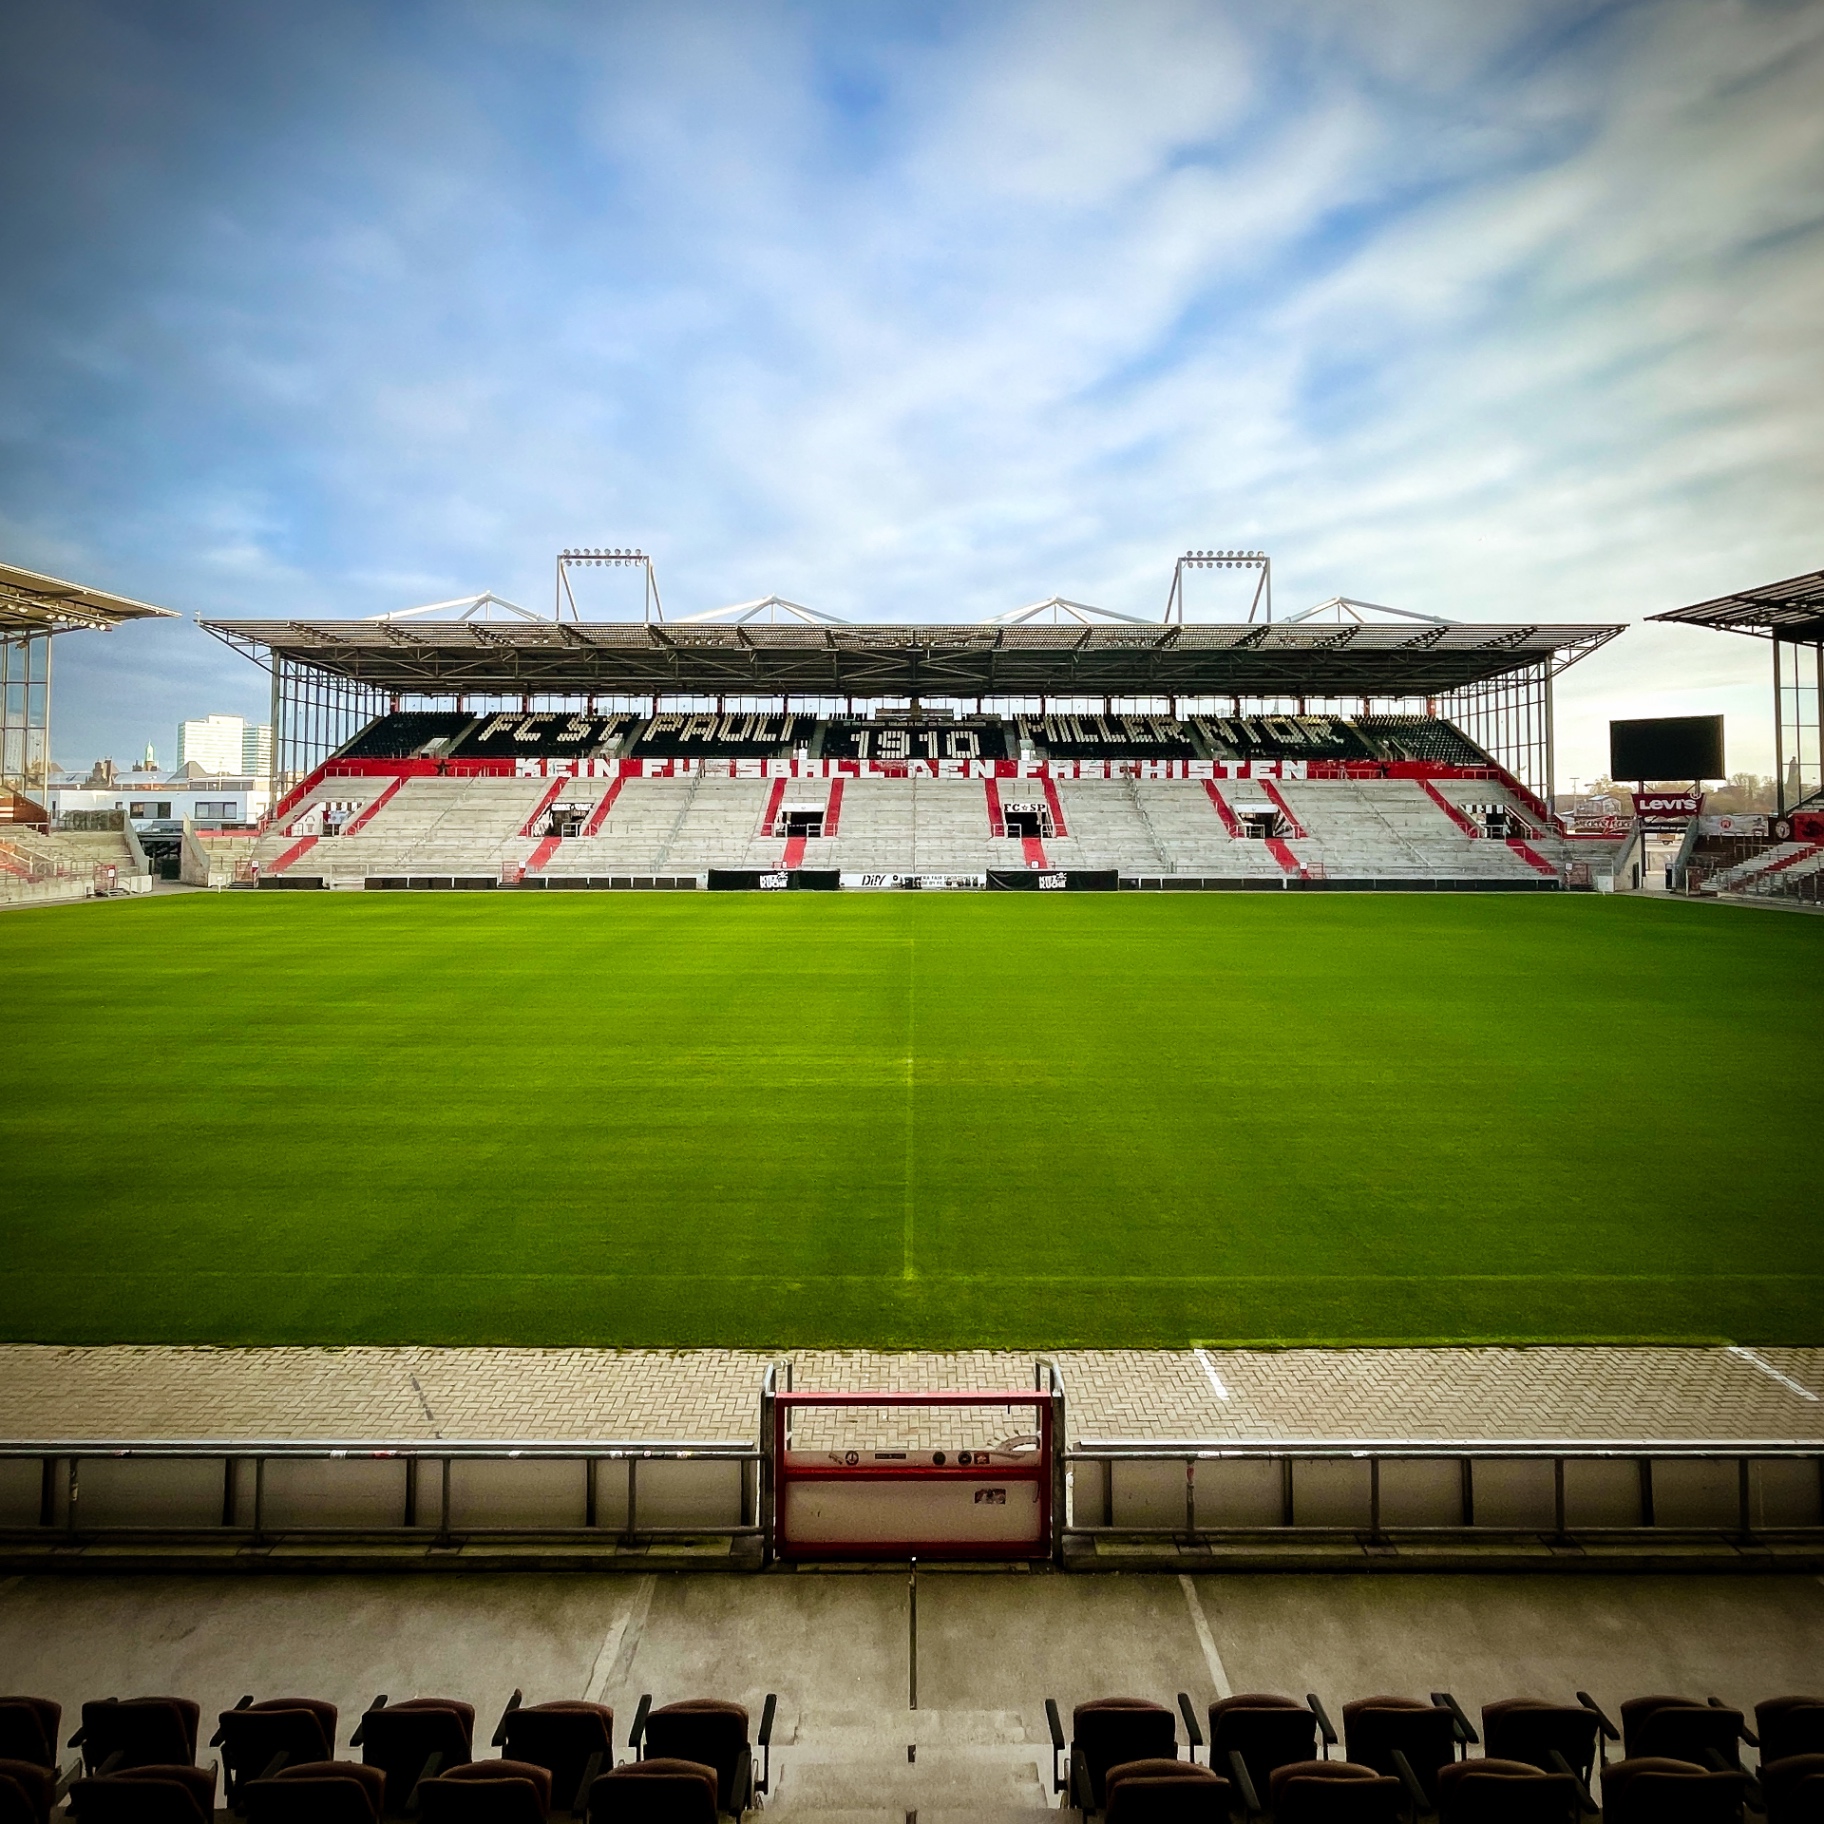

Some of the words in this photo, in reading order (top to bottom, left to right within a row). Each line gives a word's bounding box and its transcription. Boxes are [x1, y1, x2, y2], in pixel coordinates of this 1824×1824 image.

[478, 713, 556, 741] FC
[642, 714, 795, 742] PAULI
[850, 731, 981, 758] 1910
[516, 758, 620, 777] KEIN
[1017, 759, 1307, 779] FASCHISTEN
